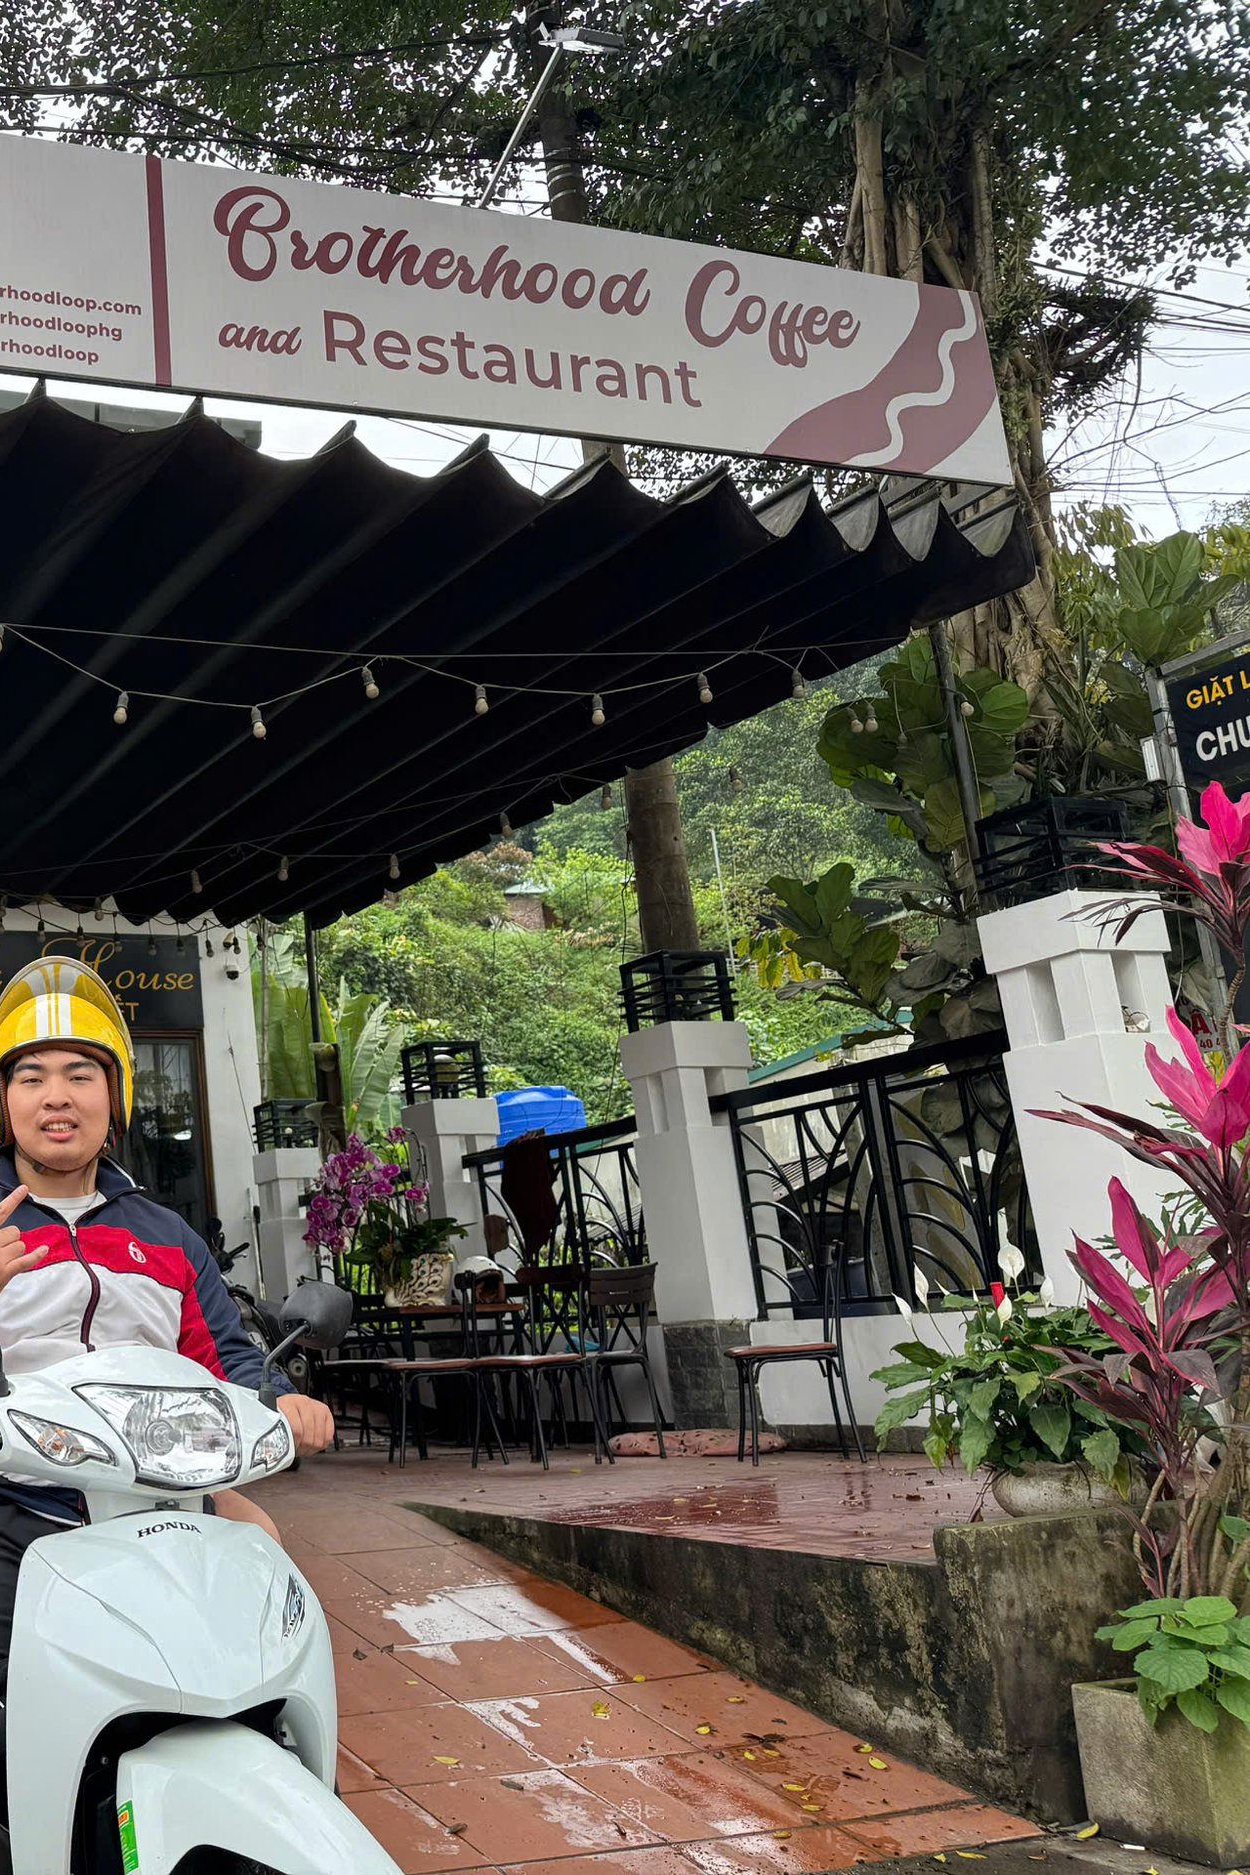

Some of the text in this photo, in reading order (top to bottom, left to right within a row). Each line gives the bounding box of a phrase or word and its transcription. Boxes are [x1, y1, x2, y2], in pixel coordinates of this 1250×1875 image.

[214, 186, 861, 368] Brotherhood Coffee
[218, 309, 704, 409] and Restaurant
[1186, 675, 1235, 710] GIẶT
[137, 1521, 202, 1538] HONDA
